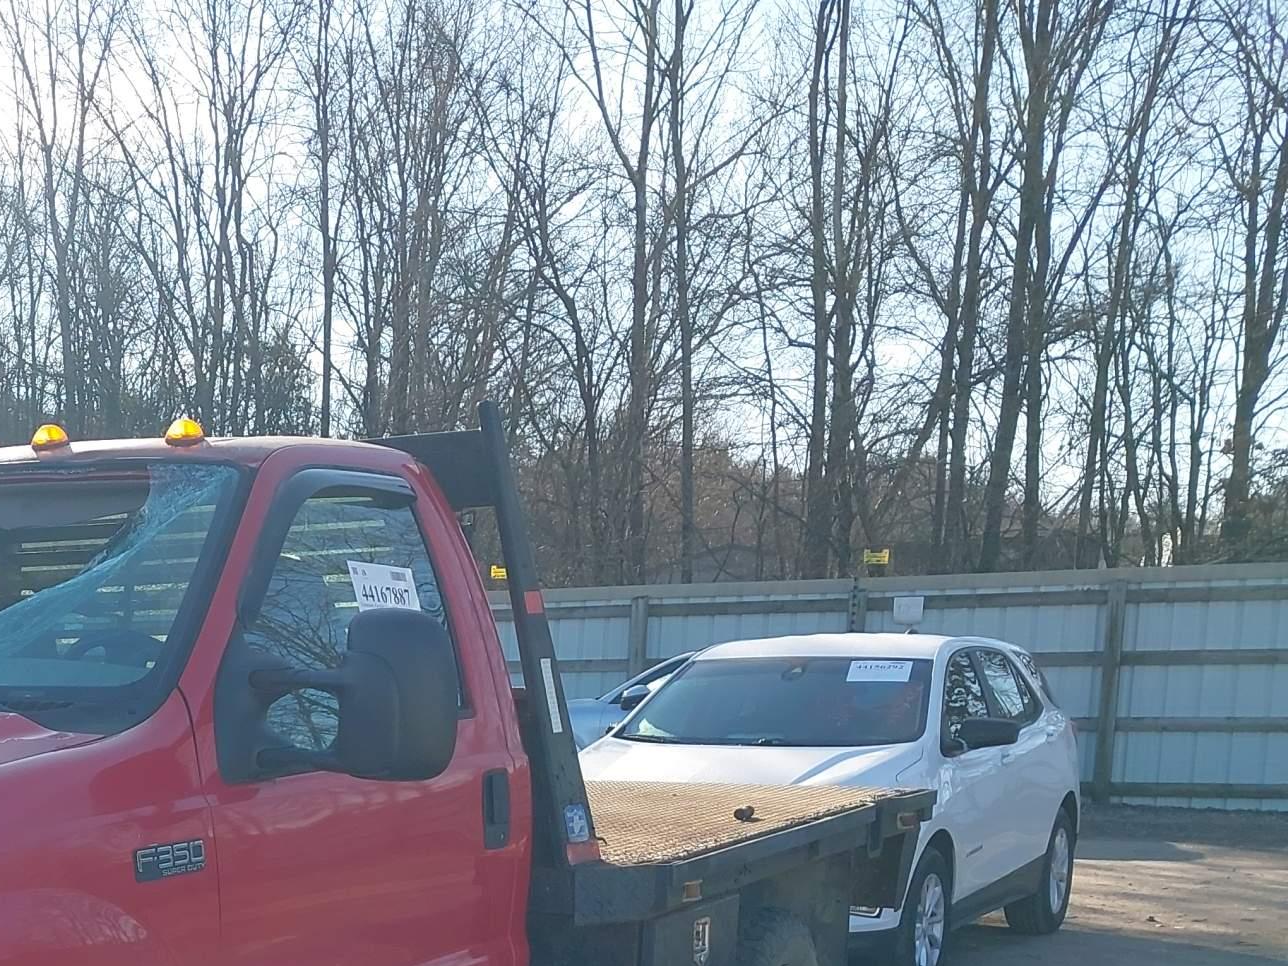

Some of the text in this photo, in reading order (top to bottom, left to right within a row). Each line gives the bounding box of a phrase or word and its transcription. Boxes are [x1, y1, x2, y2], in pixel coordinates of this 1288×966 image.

[361, 583, 411, 607] 44167887
[162, 862, 205, 877] SUPER DUTY
